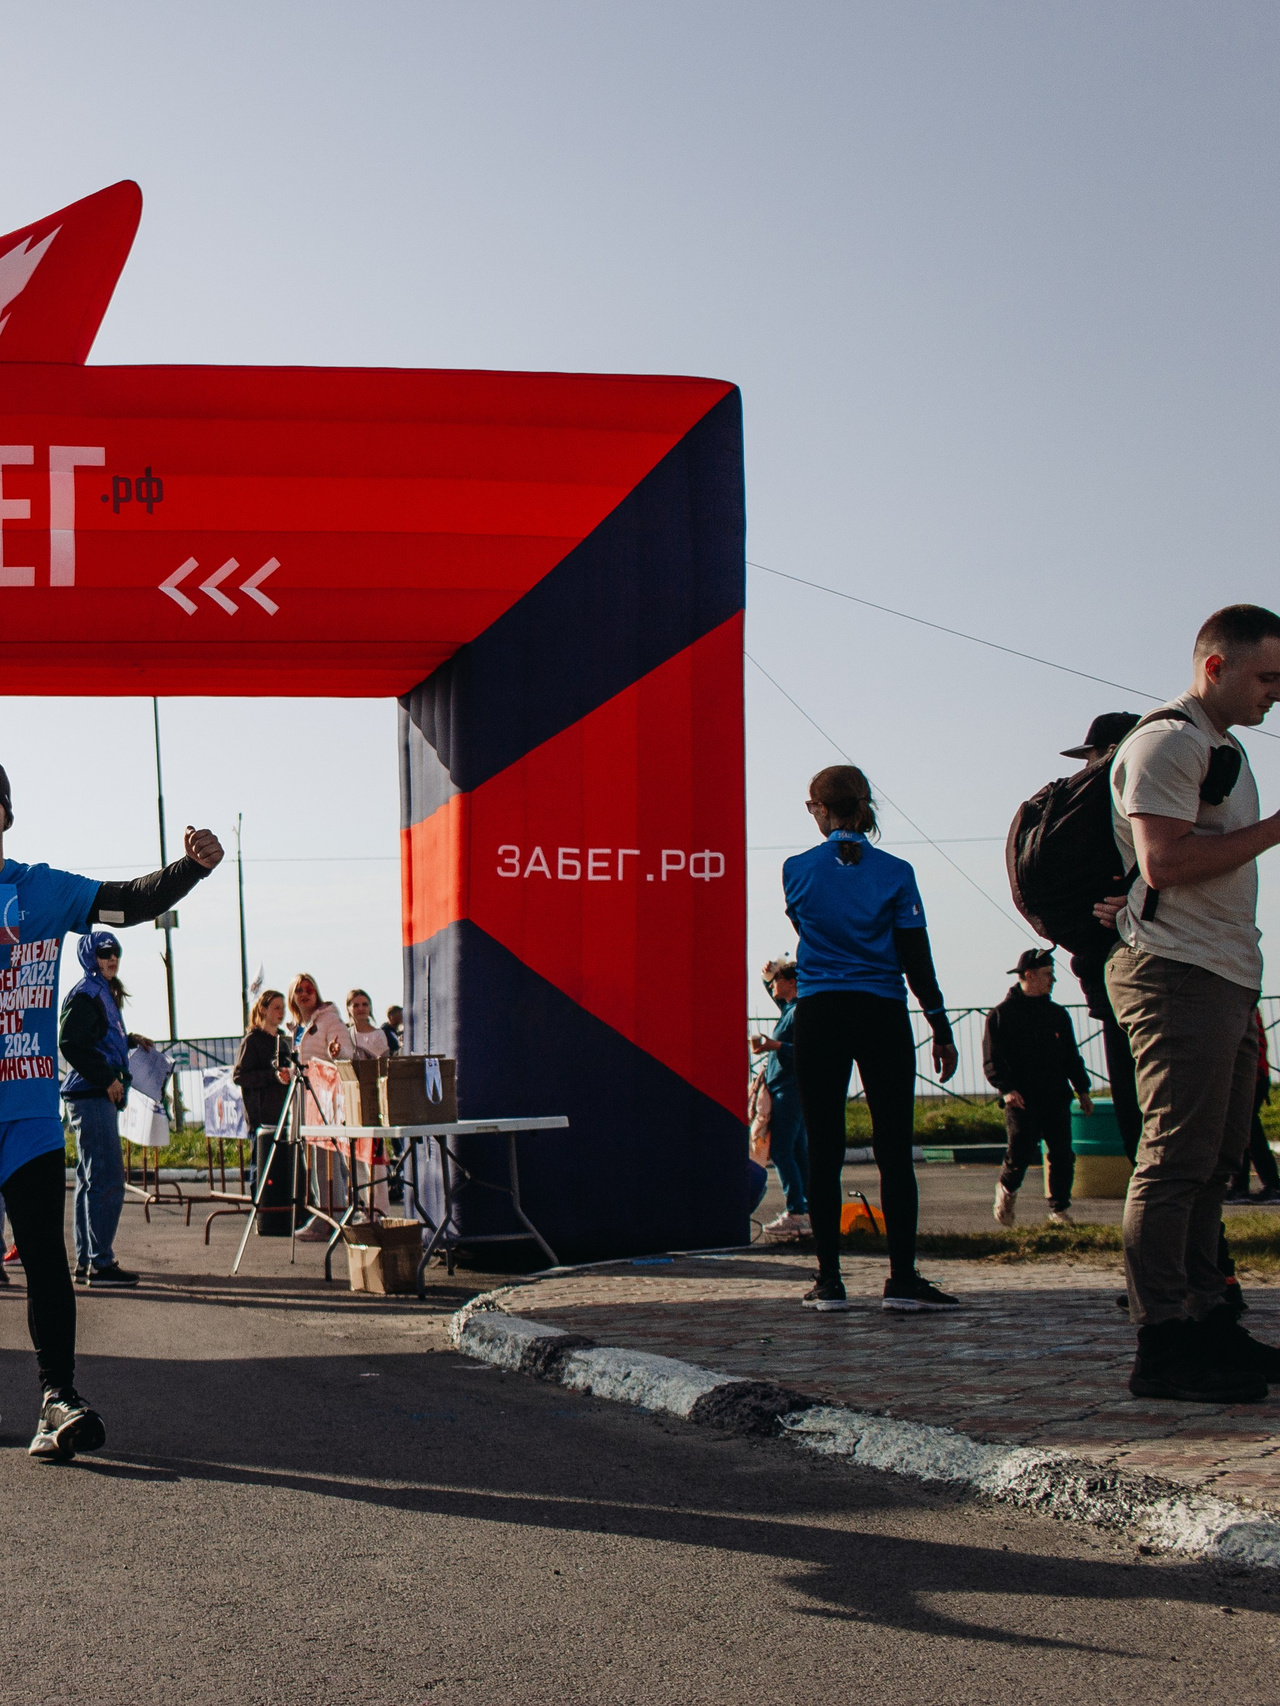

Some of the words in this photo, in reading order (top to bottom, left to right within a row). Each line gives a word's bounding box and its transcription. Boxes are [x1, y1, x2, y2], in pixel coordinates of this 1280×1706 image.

[496, 844, 726, 882] ЗАБЕГ.РФ
[10, 938, 60, 967] #ЦЕЛЬ
[4, 1032, 41, 1058] 2024
